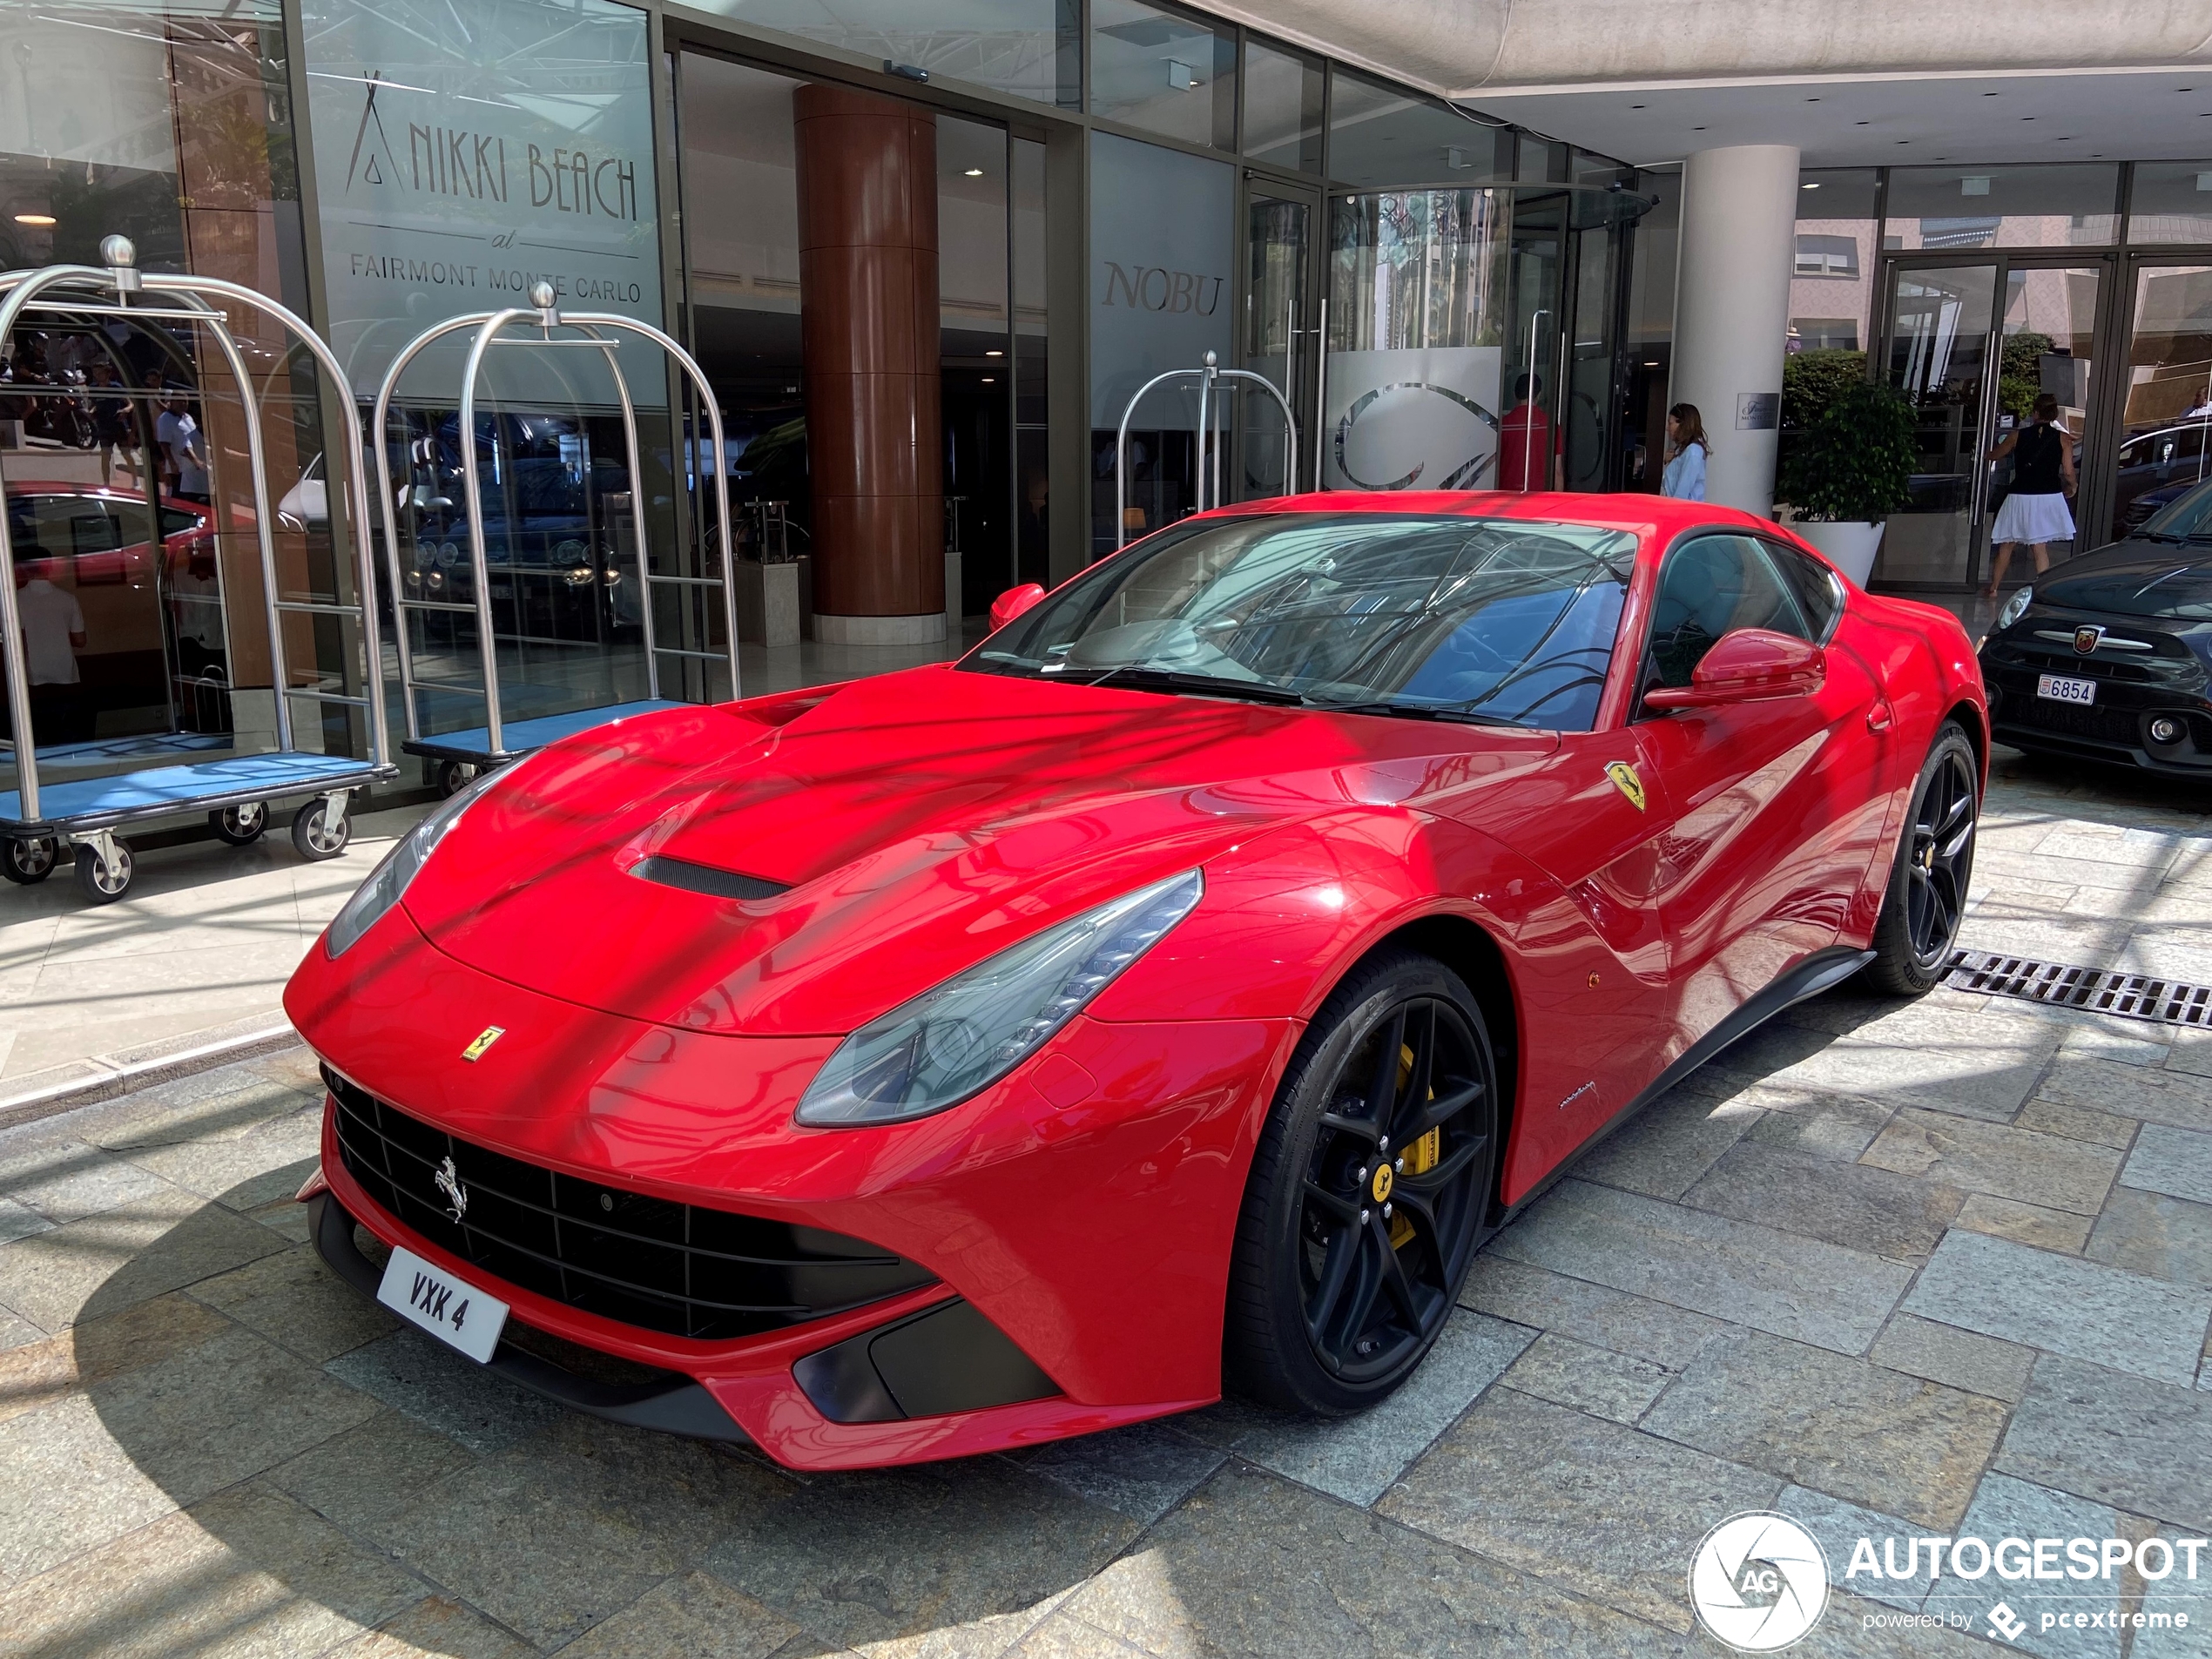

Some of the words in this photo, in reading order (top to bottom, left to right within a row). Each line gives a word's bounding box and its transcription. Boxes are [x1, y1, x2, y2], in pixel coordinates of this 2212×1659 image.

[409, 122, 508, 203] NIKKI
[527, 144, 637, 221] BEACH
[491, 229, 517, 250] at
[350, 253, 478, 287] FAIRMONT
[489, 267, 568, 296] MONTE
[575, 277, 641, 304] CARLO
[1102, 261, 1224, 317] NOBU
[2051, 680, 2090, 701] 6854
[409, 1271, 454, 1323] VXK
[450, 1298, 470, 1332] 4
